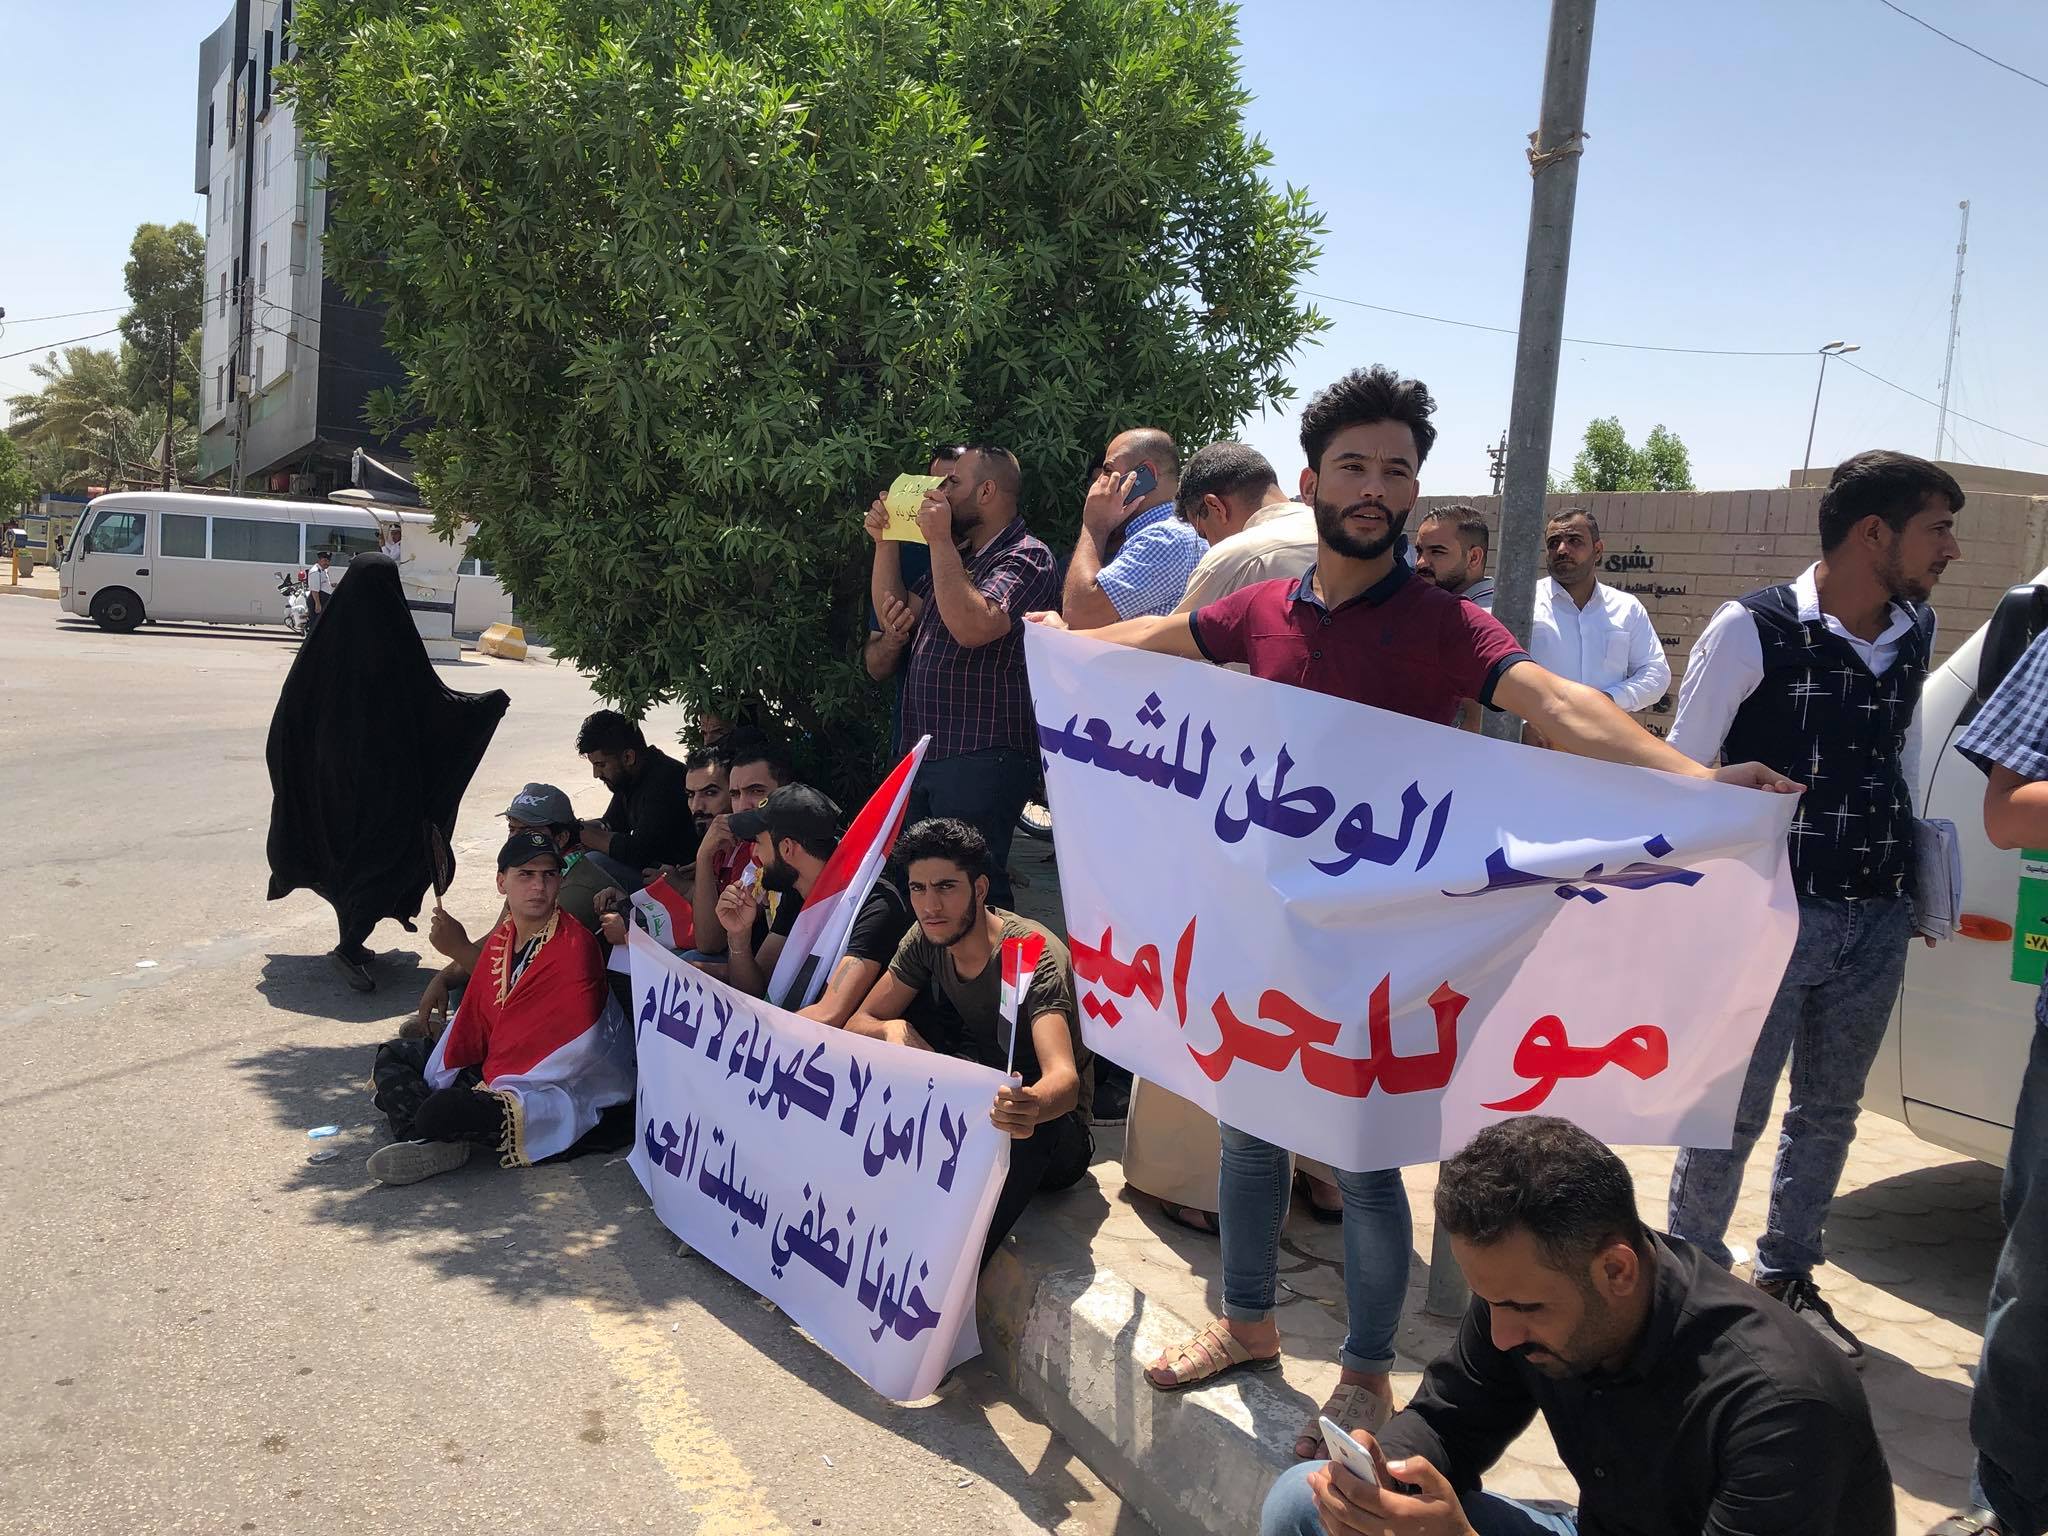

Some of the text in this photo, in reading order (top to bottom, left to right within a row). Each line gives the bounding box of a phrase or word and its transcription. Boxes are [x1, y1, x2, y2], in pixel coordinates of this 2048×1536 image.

[1214, 741, 1453, 877] الوطن
[637, 971, 967, 1193] لا أمن لا كهرباء لا نظام
[1067, 915, 1669, 1112] مو للحرامي
[641, 1088, 942, 1343] خلونا نطفي سبلت الحم
